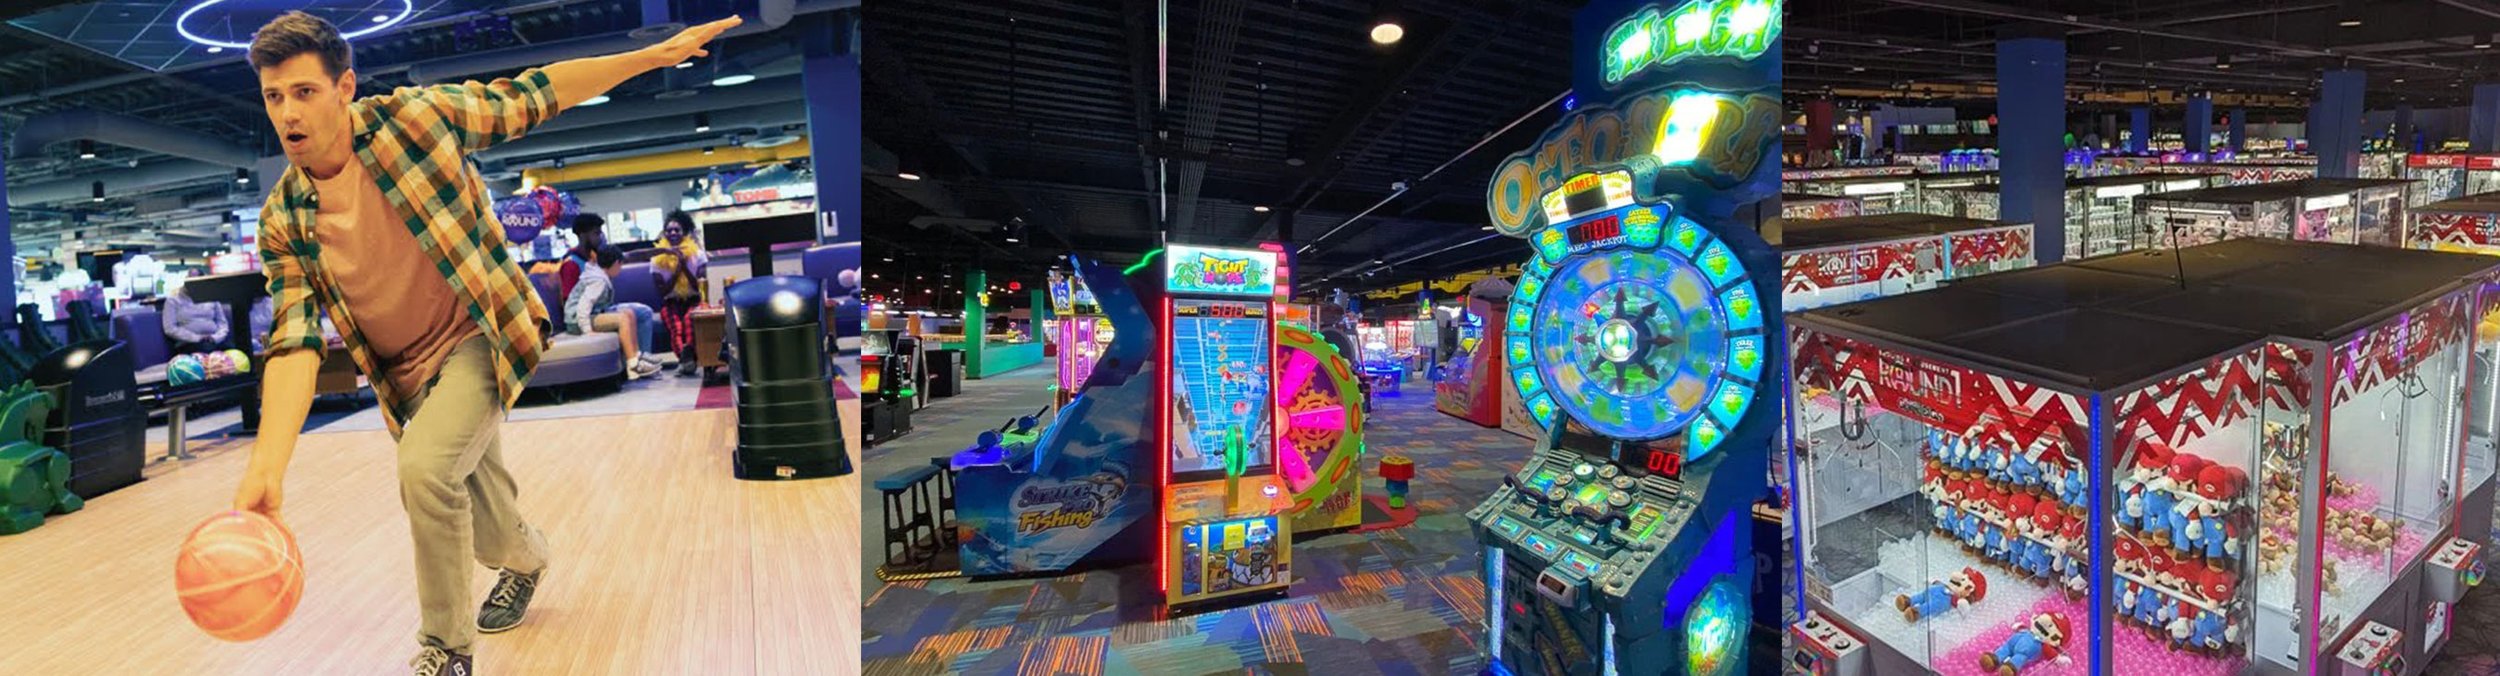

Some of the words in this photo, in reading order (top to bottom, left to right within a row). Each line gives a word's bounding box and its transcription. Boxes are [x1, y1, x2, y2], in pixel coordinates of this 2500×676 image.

[1878, 356, 1963, 409] ROUND1
[1648, 450, 1680, 476] 00
[1017, 508, 1094, 534] Fishing
